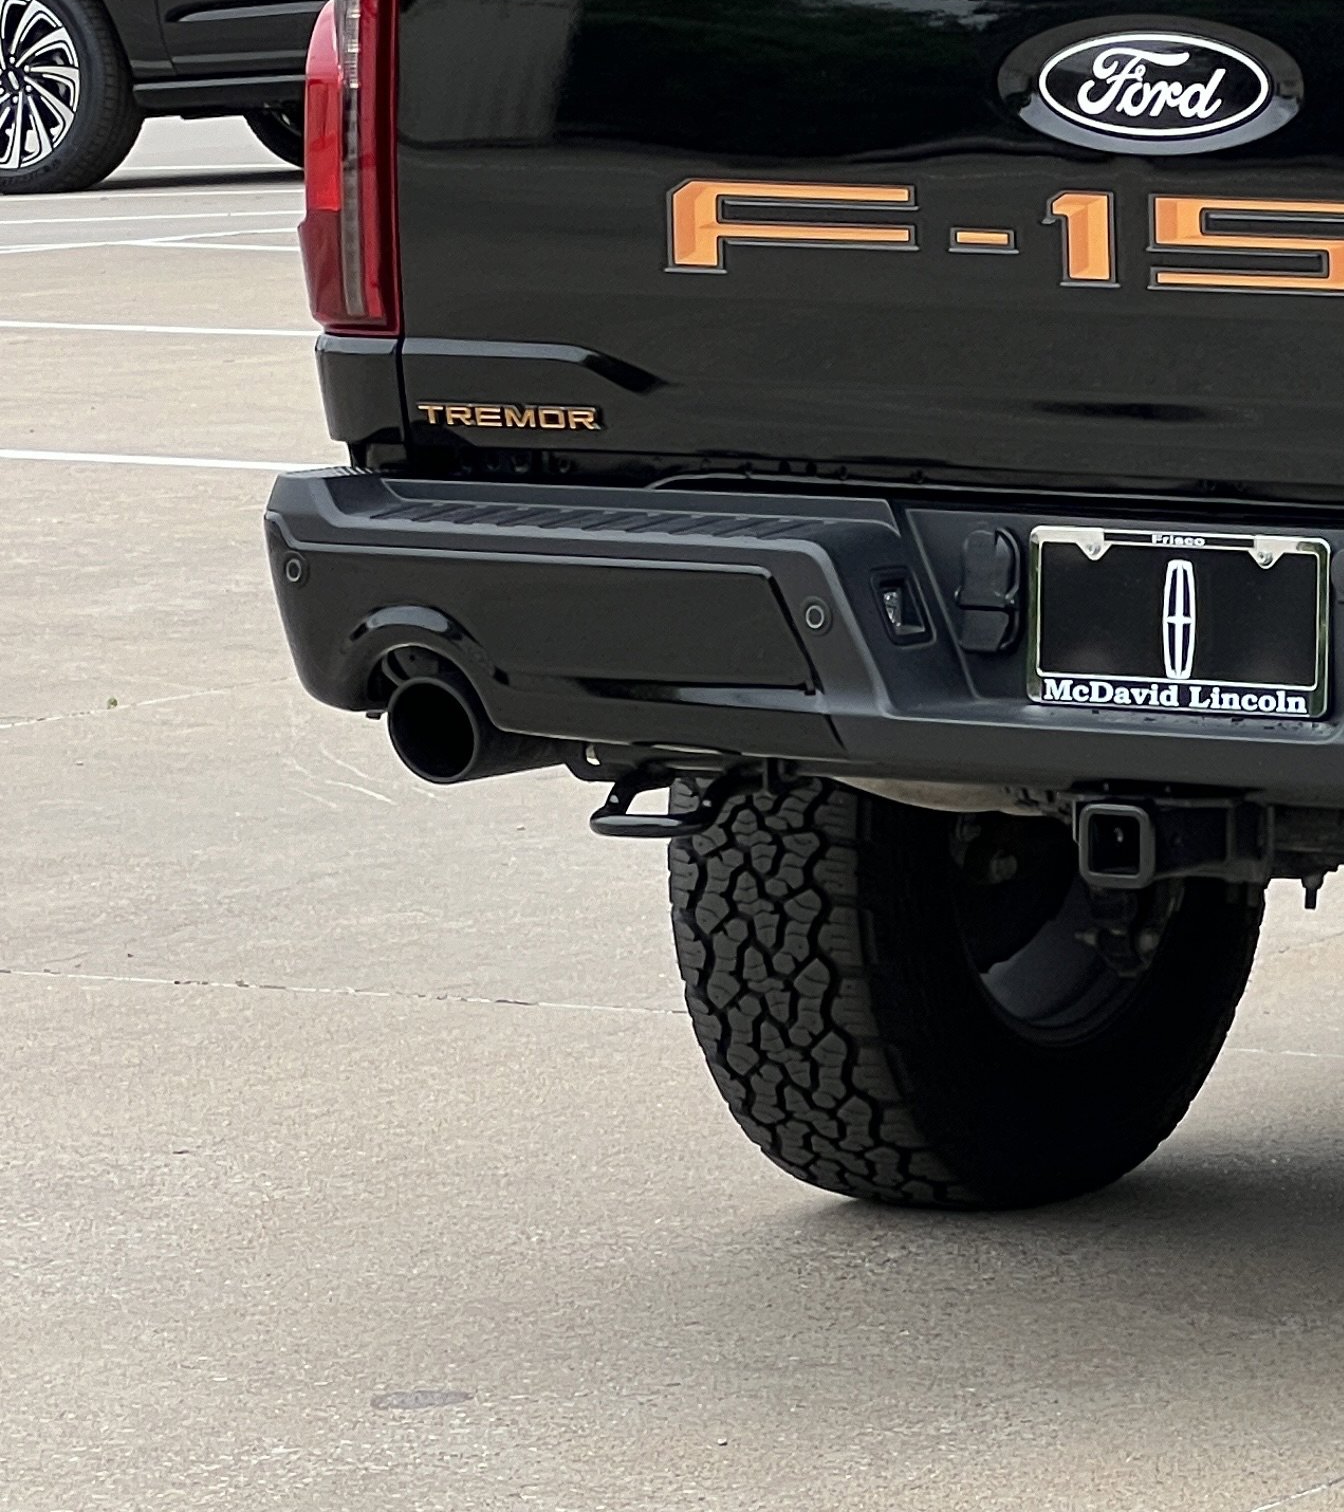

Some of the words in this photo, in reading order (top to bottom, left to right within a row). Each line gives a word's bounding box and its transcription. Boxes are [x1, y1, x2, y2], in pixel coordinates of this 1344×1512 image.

[1077, 47, 1226, 119] Ford
[416, 401, 602, 431] TREMOR
[1151, 533, 1206, 547] Frisco
[1042, 678, 1180, 708] McDavid
[1188, 686, 1308, 715] Lincoln
